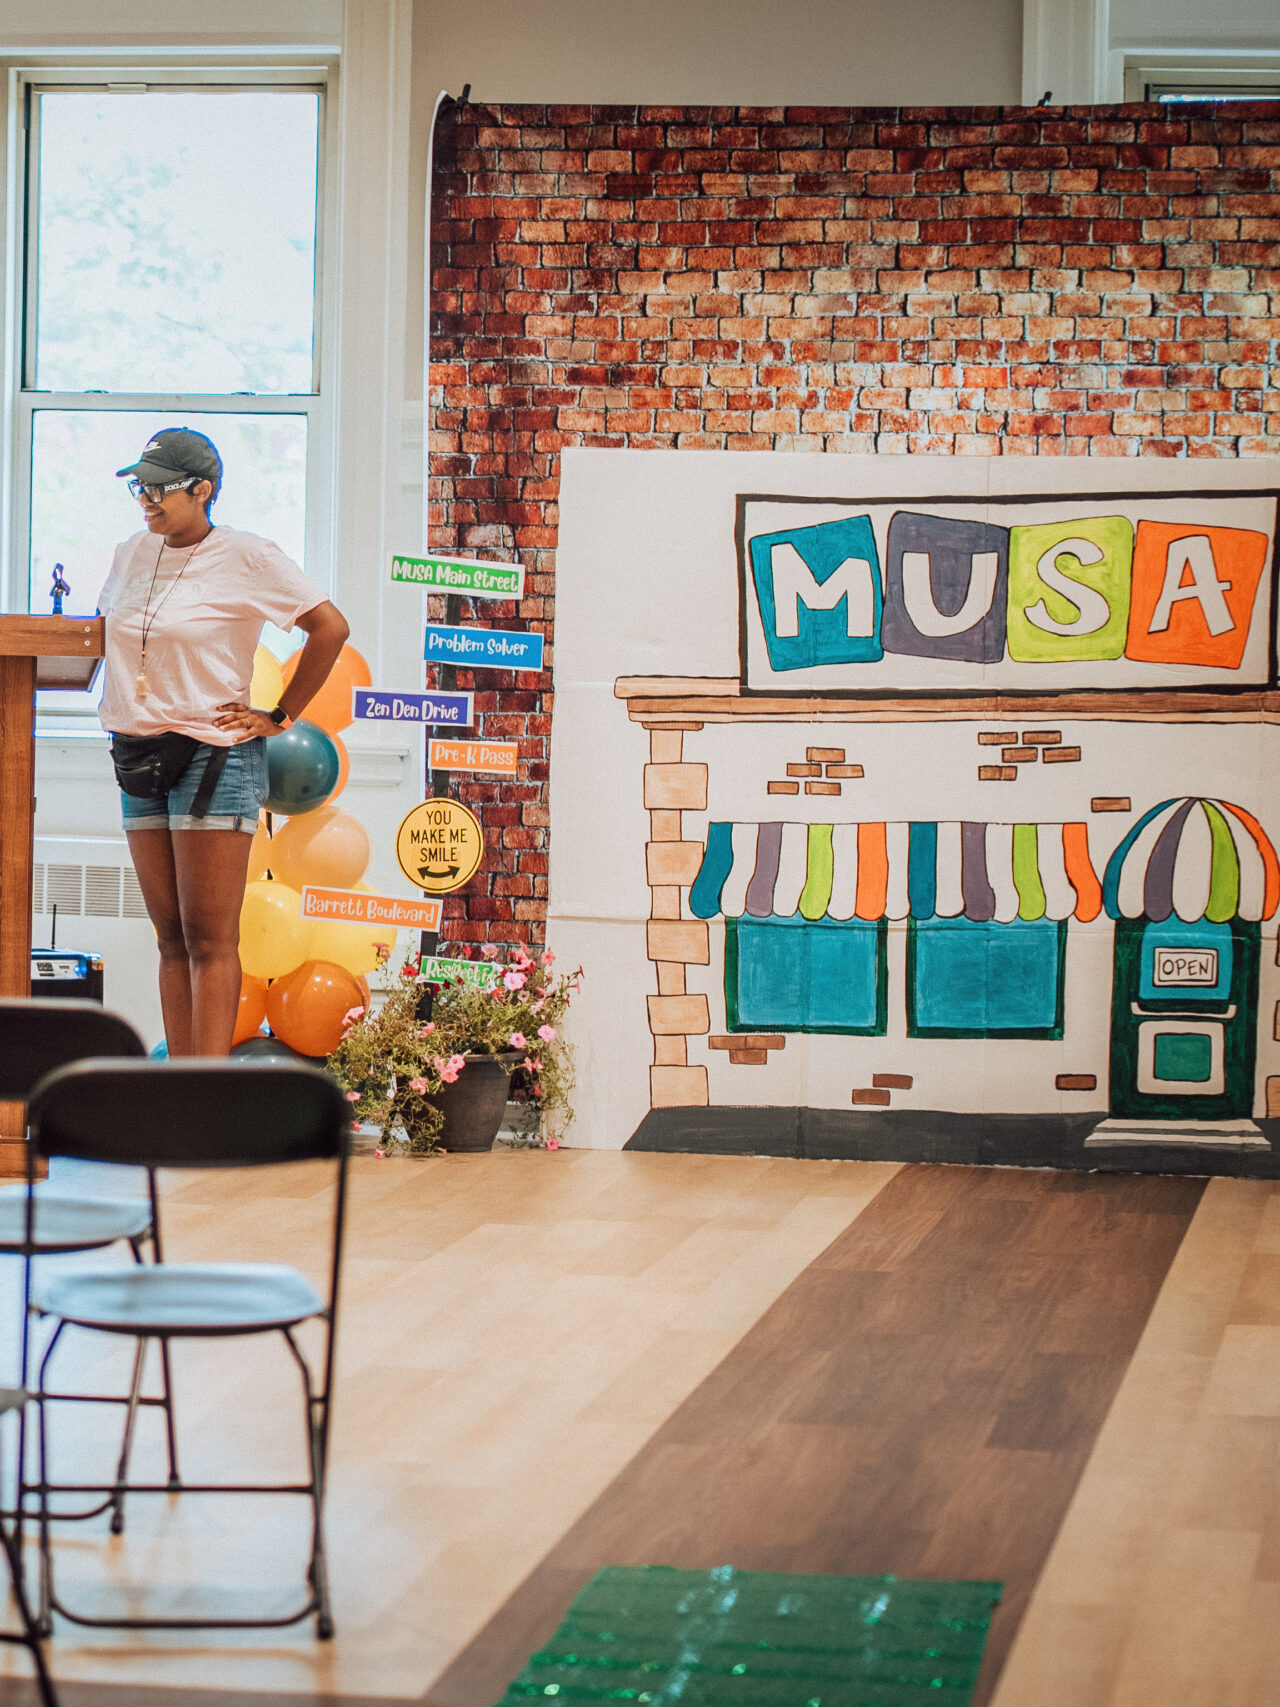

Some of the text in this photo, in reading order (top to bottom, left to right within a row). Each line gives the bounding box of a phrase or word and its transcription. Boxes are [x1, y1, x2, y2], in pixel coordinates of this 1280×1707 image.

[392, 559, 518, 592] MUSA Main Street
[770, 534, 1236, 638] MUSA
[428, 632, 529, 656] Problem Solver
[366, 697, 459, 721] Zen Den Drive
[480, 747, 514, 766] Pass
[426, 810, 452, 826] YOU
[410, 828, 468, 845] MAKE ME
[420, 847, 458, 863] SMILE
[306, 894, 436, 923] Barrett Boulevard
[1162, 957, 1210, 976] OPEN
